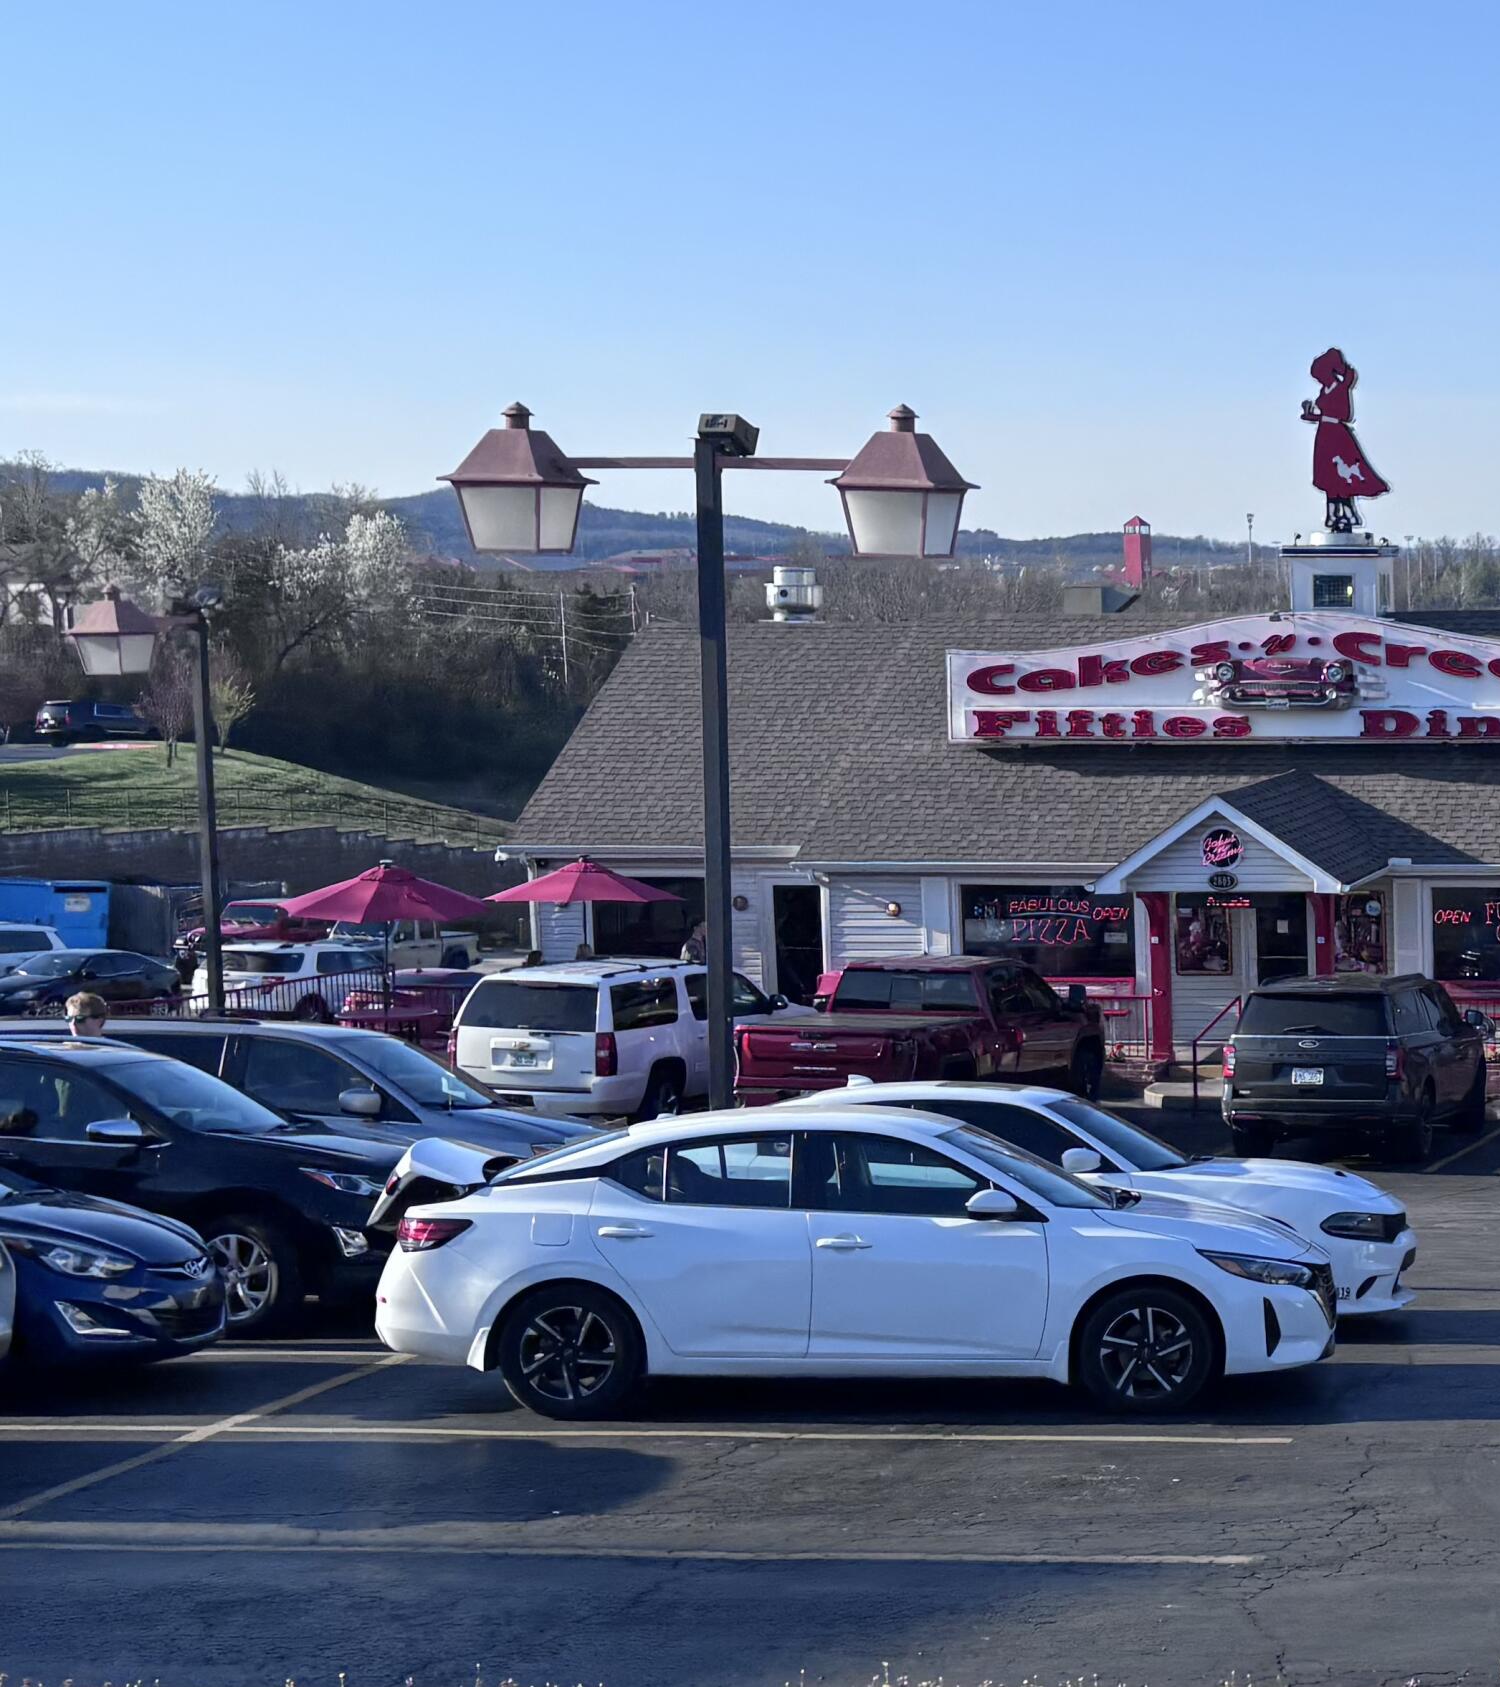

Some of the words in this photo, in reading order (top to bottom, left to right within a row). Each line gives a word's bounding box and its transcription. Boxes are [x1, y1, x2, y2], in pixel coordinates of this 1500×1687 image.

[967, 640, 1231, 695] Cakes
[972, 709, 1252, 738] Fifties
[1009, 898, 1090, 913] FABULOUS
[1092, 907, 1130, 921] OPEN
[1434, 909, 1472, 924] OPEN
[1012, 918, 1091, 945] PIZZA
